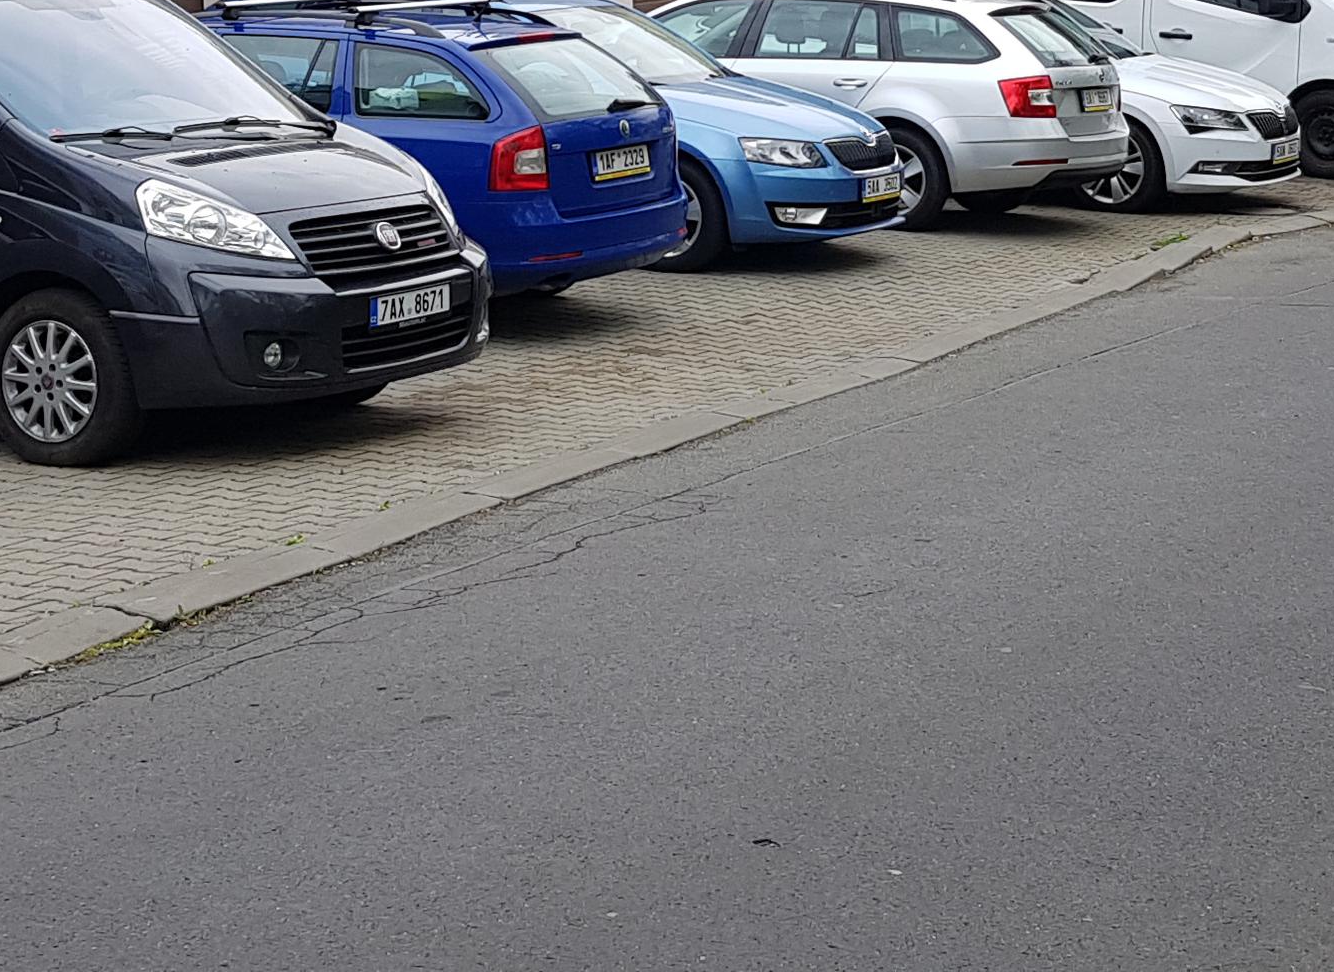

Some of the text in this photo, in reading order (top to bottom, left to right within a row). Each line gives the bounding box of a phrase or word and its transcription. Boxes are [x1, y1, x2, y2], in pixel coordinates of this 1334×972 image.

[599, 148, 645, 171] 1AF 2329
[380, 288, 444, 322] 7AX 8671
